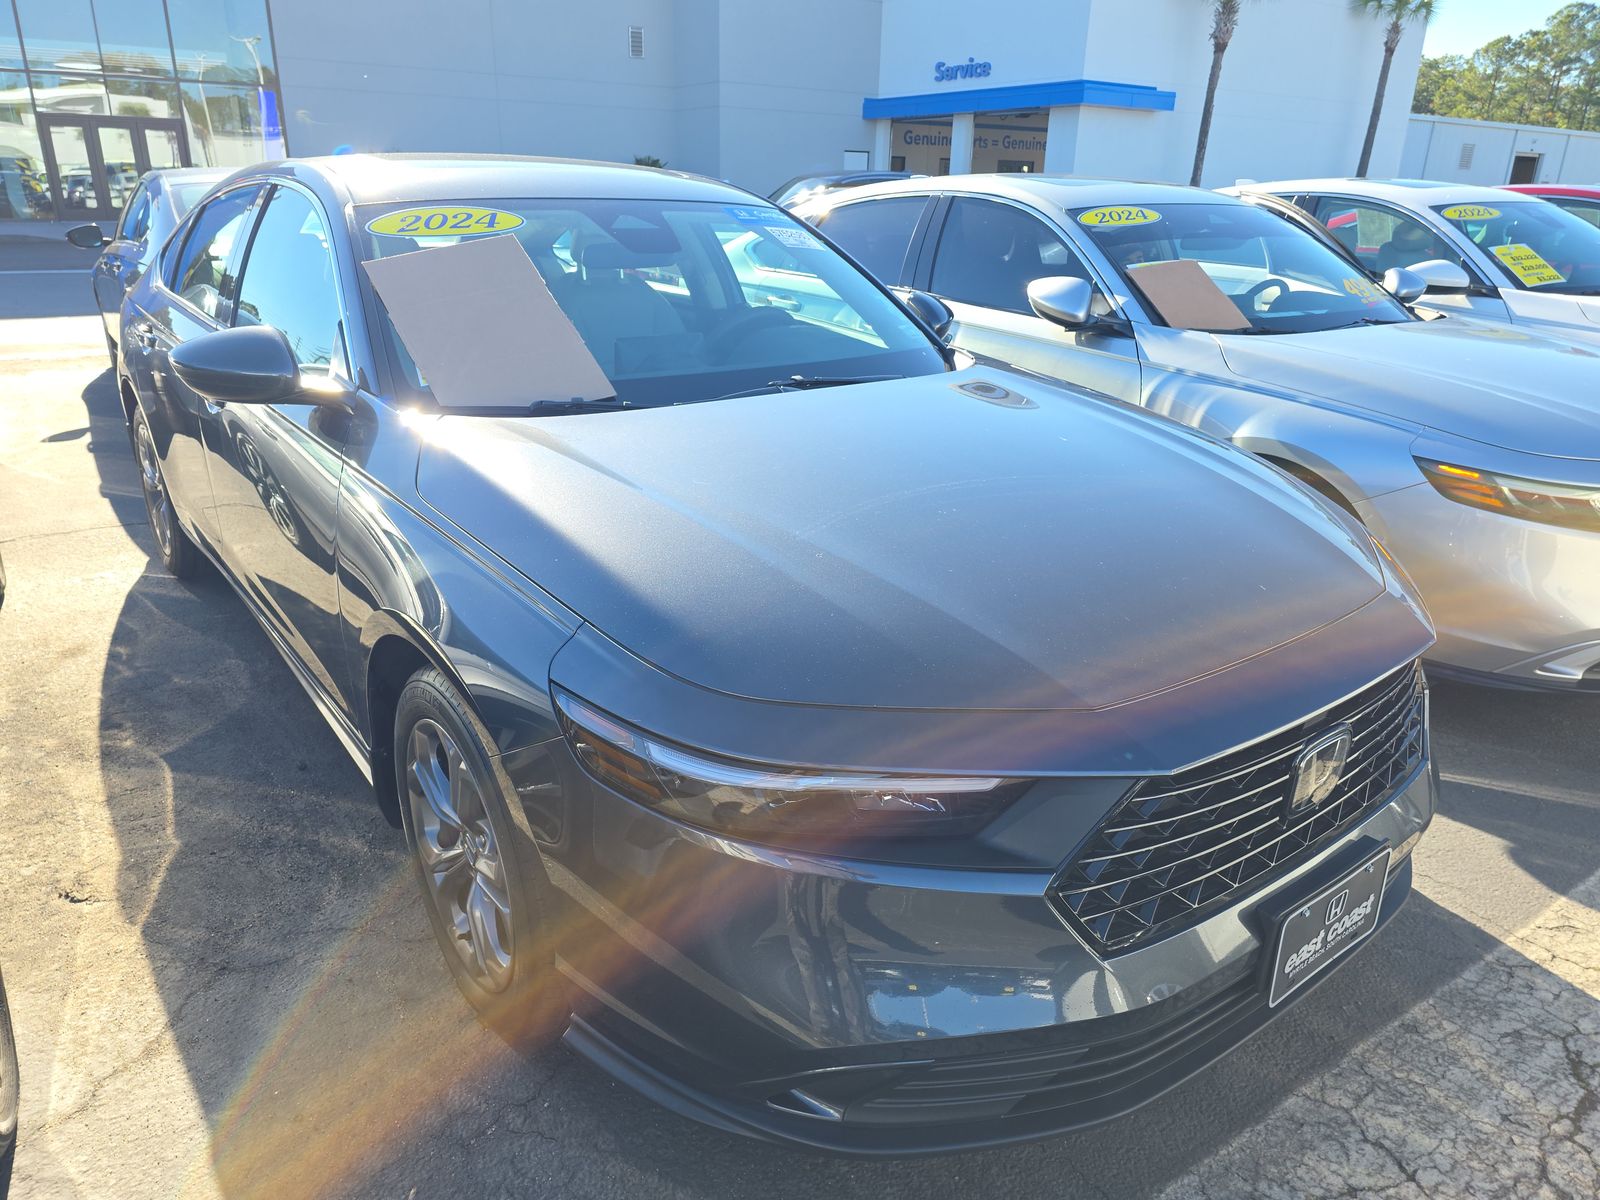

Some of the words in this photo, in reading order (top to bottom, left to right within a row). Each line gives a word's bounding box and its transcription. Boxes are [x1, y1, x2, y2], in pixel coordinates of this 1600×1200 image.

[934, 57, 992, 82] Service
[397, 212, 501, 233] 2024
[1095, 209, 1149, 224] 2024
[1455, 207, 1495, 219] 2024
[1284, 929, 1325, 974] east
[1326, 893, 1375, 942] coast
